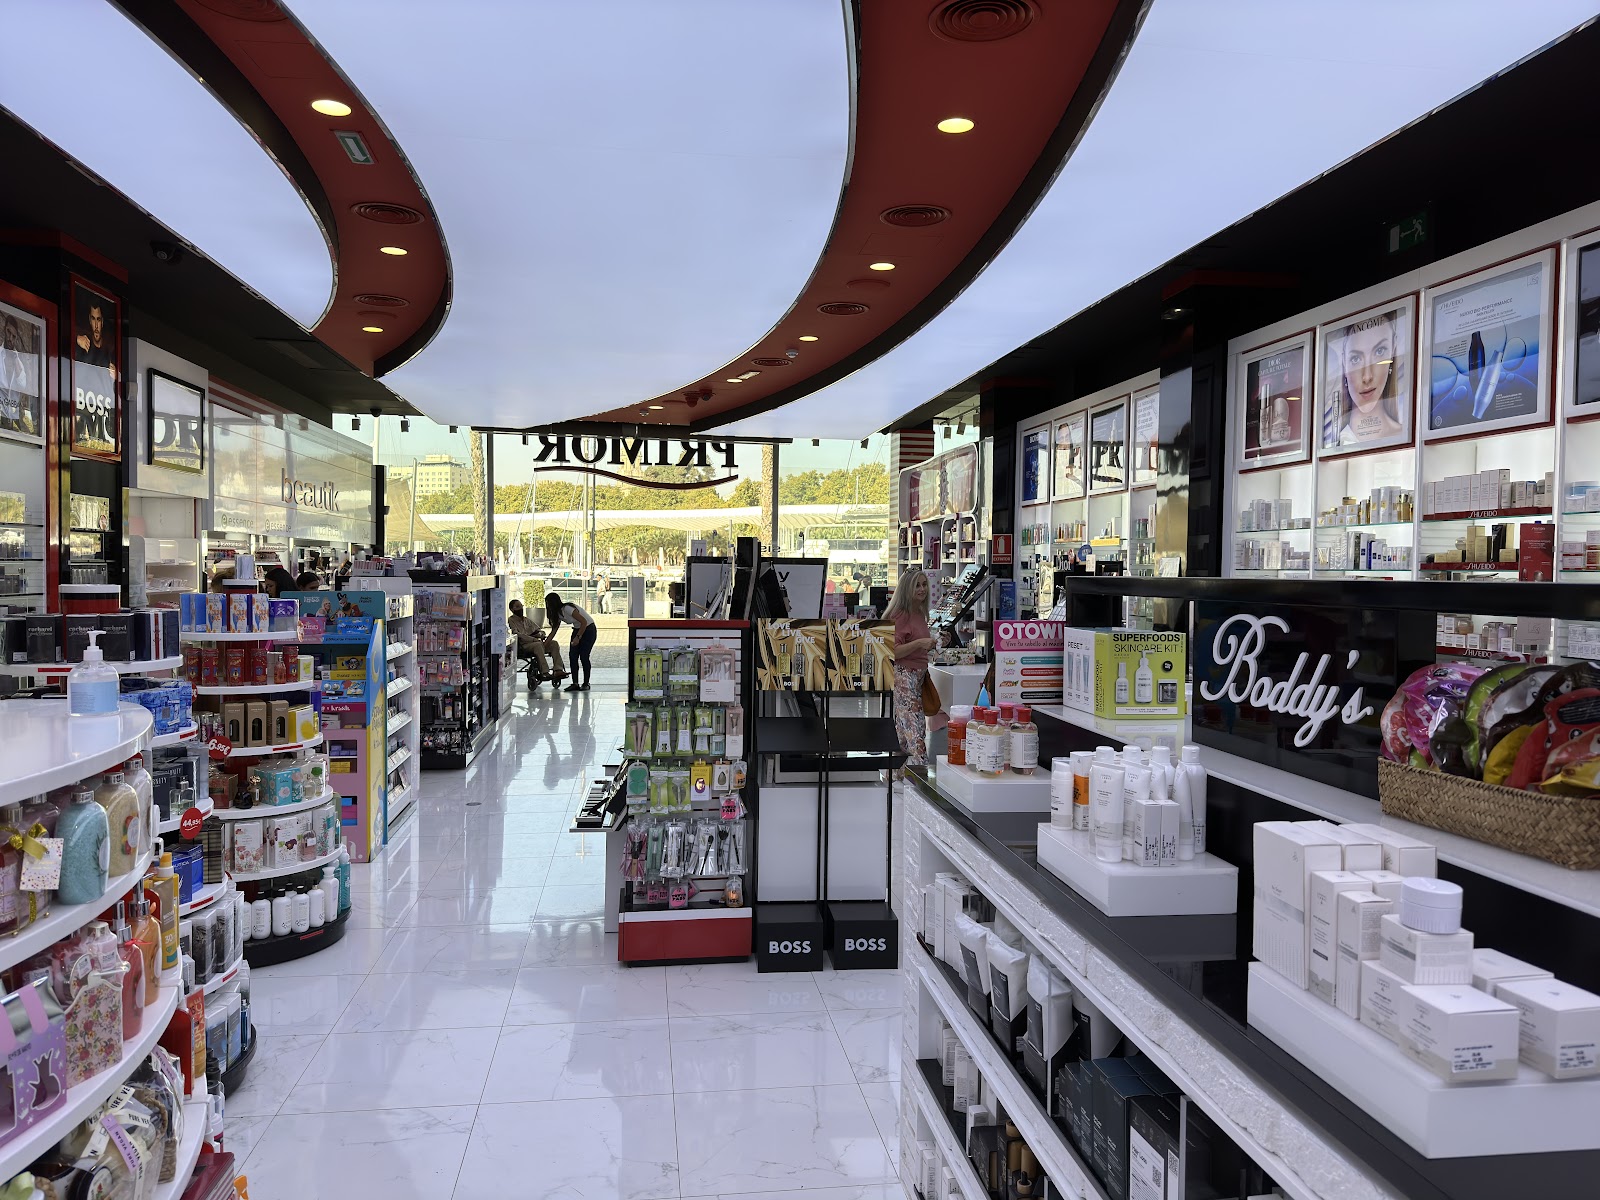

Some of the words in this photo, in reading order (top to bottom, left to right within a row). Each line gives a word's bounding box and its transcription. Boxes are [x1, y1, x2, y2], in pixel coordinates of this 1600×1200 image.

[76, 388, 112, 417] BOSS
[281, 468, 340, 512] beautik
[1468, 510, 1498, 518] SHISEIDO
[228, 517, 255, 530] essence
[270, 523, 292, 533] essence
[1466, 562, 1496, 570] SHISEIDO
[838, 623, 860, 631] LOVE
[998, 623, 1064, 640] OTOWI
[782, 629, 802, 637] LIVE
[851, 629, 871, 637] LIVE
[1113, 633, 1181, 642] SUPERFOODS
[796, 636, 816, 644] GIVE
[865, 636, 885, 644] GIVE
[1114, 643, 1163, 653] SKINCARE
[1164, 643, 1179, 653] KIT
[1463, 649, 1493, 658] SHISEIDO
[1201, 613, 1375, 748] Boddy's
[768, 941, 812, 955] BOSS
[845, 938, 887, 951] BOSS
[110, 1095, 123, 1110] URE
[140, 1115, 150, 1125] VEG
[115, 1131, 128, 1152] VEGAN
